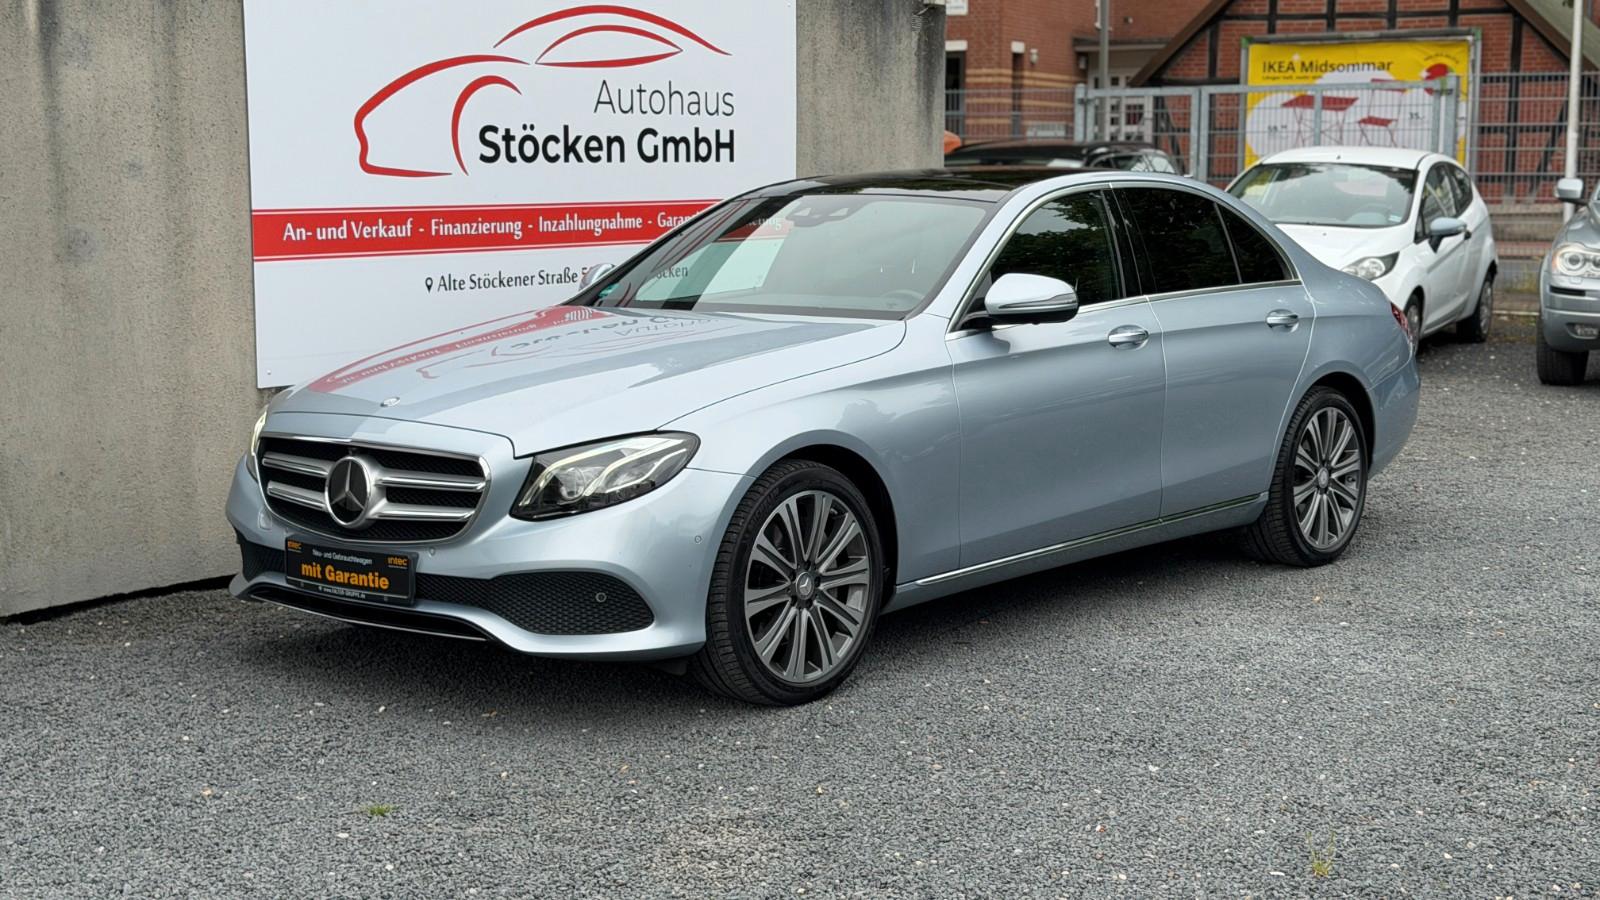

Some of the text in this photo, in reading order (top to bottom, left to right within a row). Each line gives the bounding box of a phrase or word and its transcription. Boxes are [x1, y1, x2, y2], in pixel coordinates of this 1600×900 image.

[1262, 59, 1394, 73] IKEA Midsommar
[594, 79, 735, 116] Autohaus
[479, 123, 735, 164] Stöcken GmbH
[283, 222, 313, 241] An-
[316, 219, 348, 240] und
[350, 217, 414, 239] Verkauf
[431, 217, 523, 240] Finanzierung
[539, 212, 643, 237] Inzahlungnahme
[437, 273, 466, 292] Alte
[469, 270, 535, 290] Stöckener
[538, 266, 578, 285] Straße
[301, 562, 390, 590] mit Garantie
